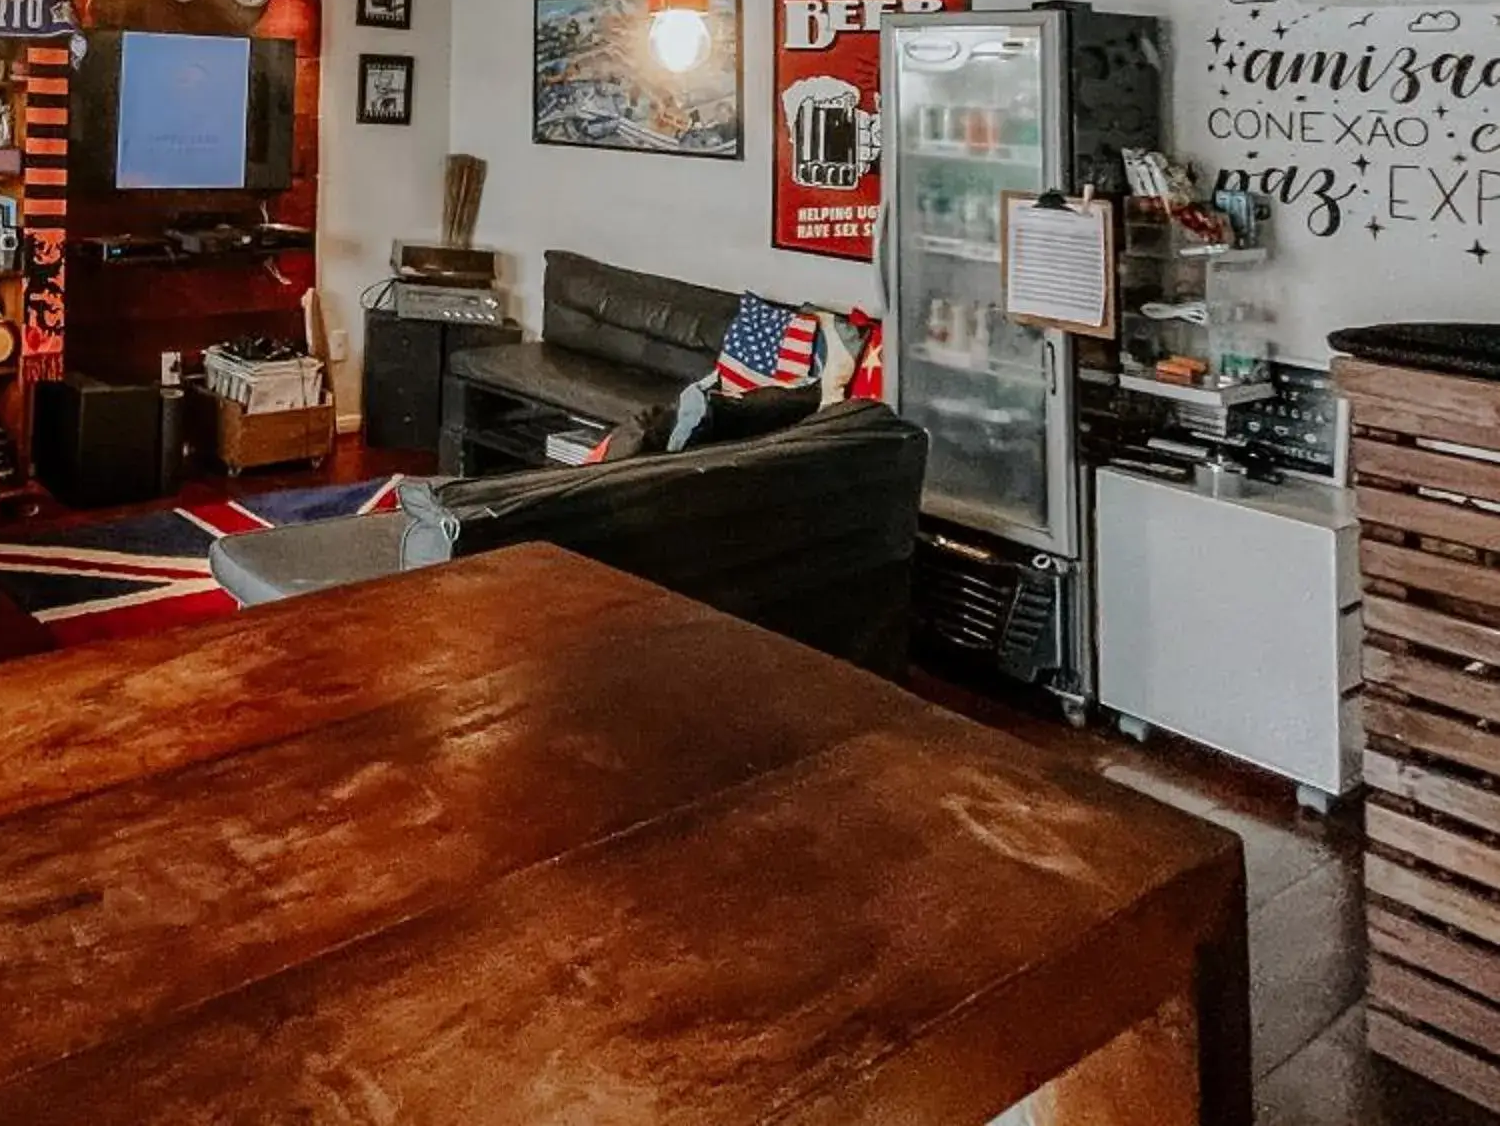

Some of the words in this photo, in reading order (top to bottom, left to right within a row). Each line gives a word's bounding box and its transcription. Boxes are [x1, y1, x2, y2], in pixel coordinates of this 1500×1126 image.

[1207, 108, 1430, 149] CONEXÃO
[797, 206, 853, 223] HELPING
[796, 224, 831, 239] HAVE
[833, 222, 859, 237] SEX
